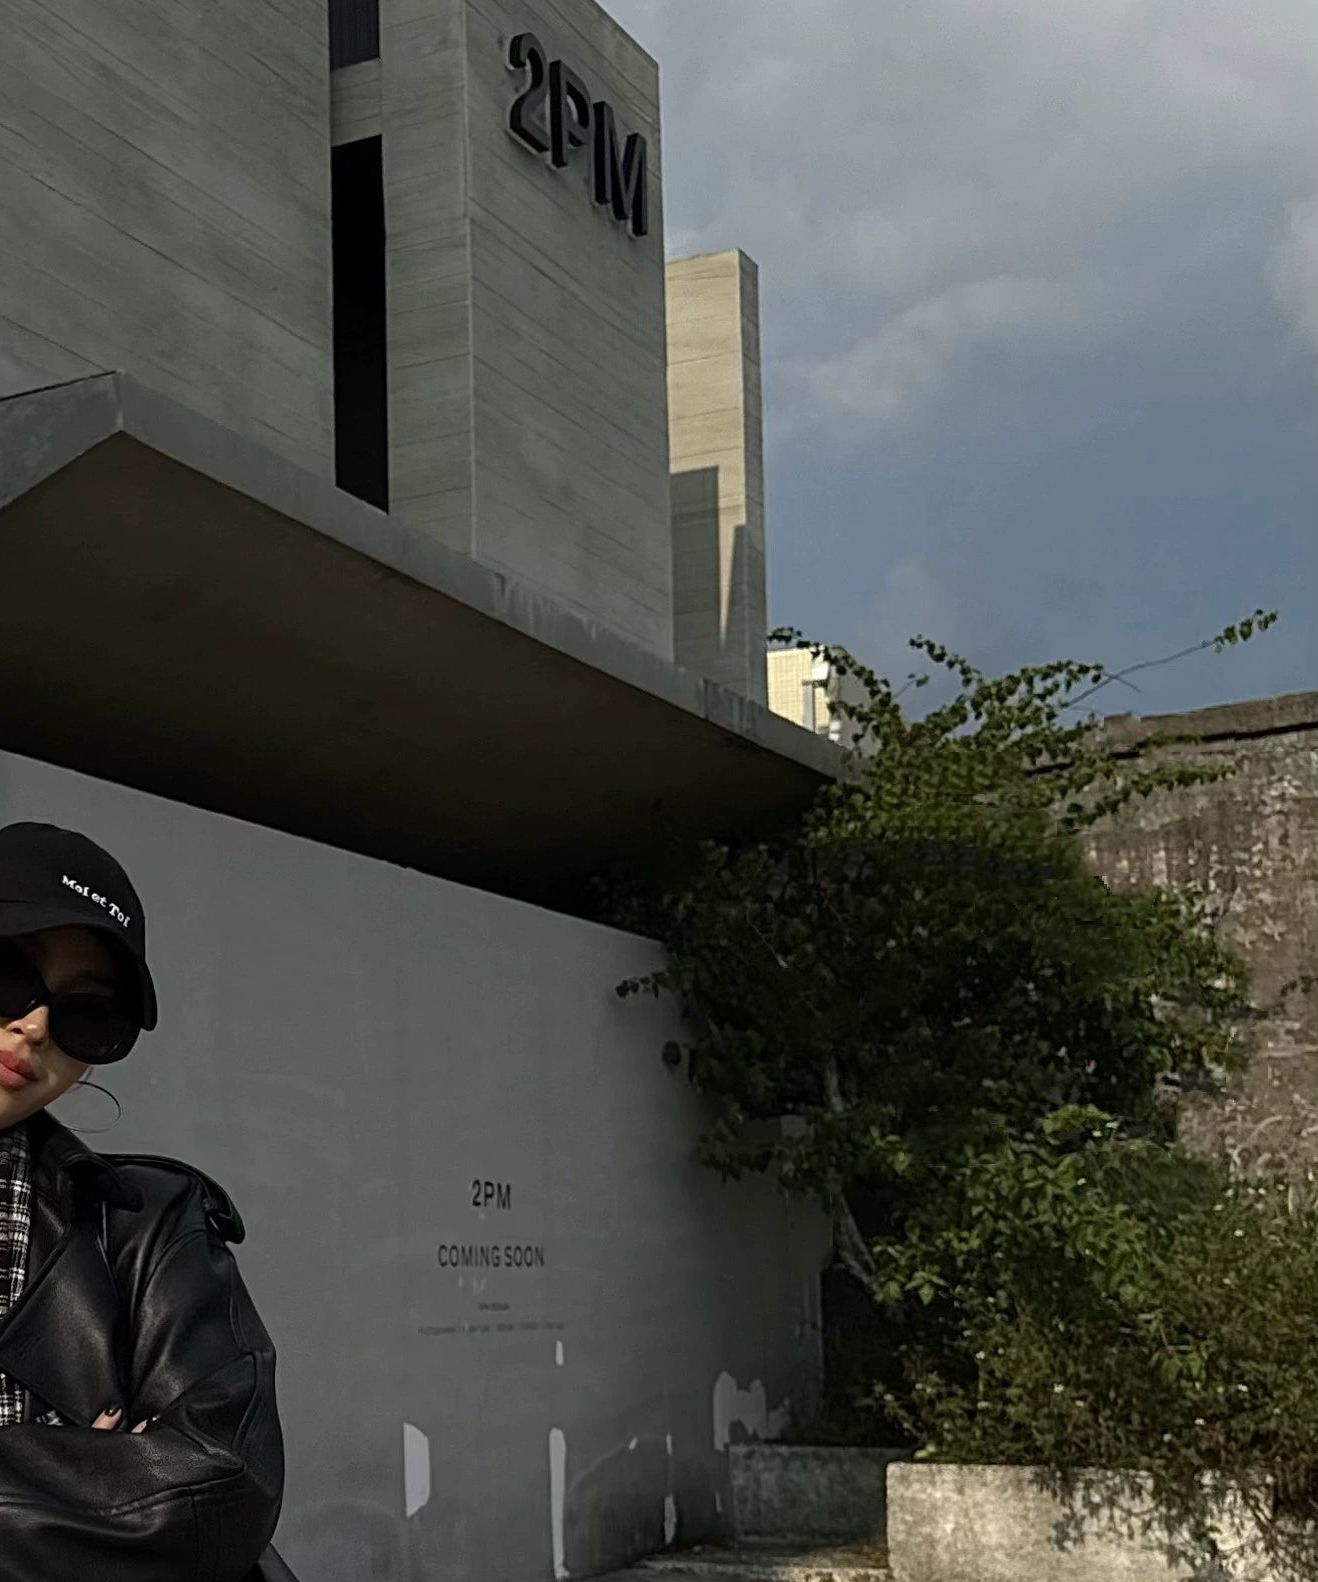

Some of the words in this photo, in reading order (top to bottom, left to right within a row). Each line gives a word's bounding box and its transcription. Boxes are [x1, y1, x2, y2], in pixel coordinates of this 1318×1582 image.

[506, 31, 648, 238] 2PM
[472, 1179, 512, 1210] 2PM
[437, 1244, 502, 1269] COMING
[504, 1245, 546, 1269] SOON
